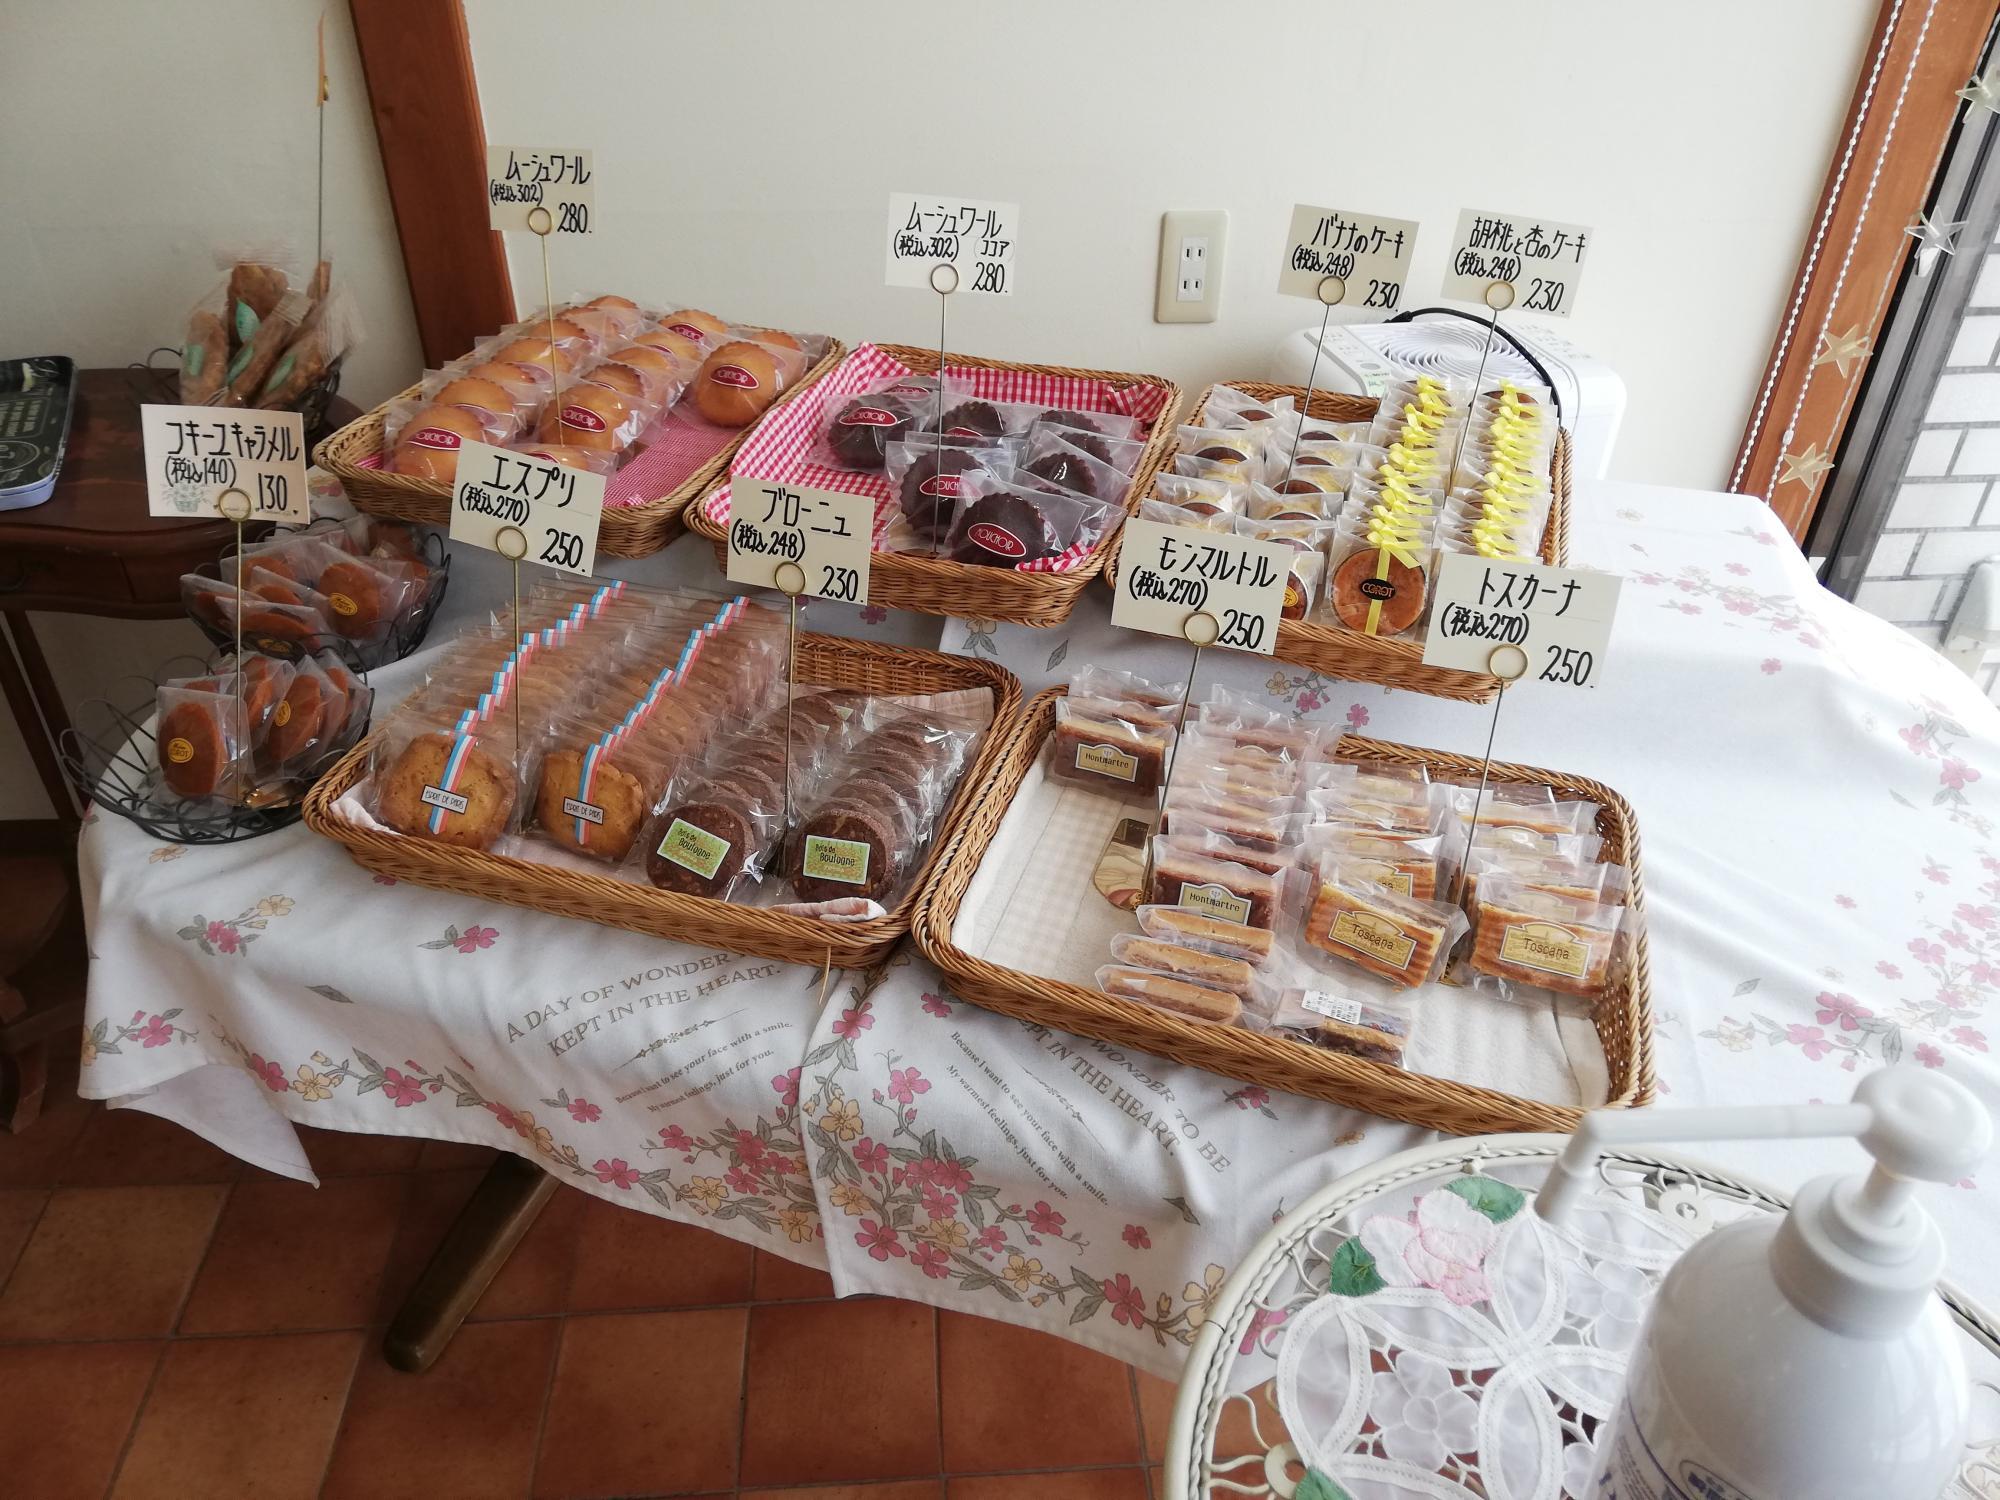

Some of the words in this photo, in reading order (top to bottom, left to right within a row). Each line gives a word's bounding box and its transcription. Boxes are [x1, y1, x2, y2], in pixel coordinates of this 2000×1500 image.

[505, 150, 591, 185] ムーシュワール
[490, 179, 543, 206] (税込302)
[905, 201, 1002, 239] ムーシュワール
[1310, 213, 1404, 259] バナナのケーキ
[1468, 216, 1586, 263] 胡桃と杏のケーキ
[893, 229, 959, 262] (税込302)
[1291, 244, 1355, 280] (税込248)
[1454, 247, 1521, 283] (税込248)
[165, 456, 236, 487] (税込140)
[482, 454, 576, 508] エスプリ
[459, 482, 530, 526] (税込270)
[762, 487, 852, 537] ブローニュ
[731, 518, 806, 562] (税込248)
[1159, 536, 1278, 588] モンマルトル
[1129, 565, 1209, 611] (税込270)
[1361, 582, 1394, 598] COROT
[1478, 567, 1582, 616] トスカーナ
[1440, 602, 1530, 645] (税込270)
[1085, 752, 1129, 769] Montmartre
[678, 837, 711, 860] Boulogne
[819, 852, 855, 867] Boulogne
[1189, 892, 1240, 912] Montmartre
[1351, 923, 1395, 950] Toscana
[1523, 937, 1570, 960] Toscana
[506, 1022, 525, 1043] A
[524, 997, 571, 1031] DAY
[580, 984, 615, 1003] OF
[619, 953, 731, 990] WONDER
[547, 1016, 601, 1057] KEPT
[608, 1003, 635, 1024] IN
[640, 988, 691, 1009] THE
[696, 964, 781, 996] HEART.
[684, 1055, 705, 1073] your
[707, 1046, 728, 1058] face
[730, 1033, 752, 1048] with
[762, 1022, 793, 1033] smile.
[715, 1067, 734, 1085] just
[735, 1058, 750, 1071] for
[752, 1049, 774, 1065] you.
[951, 1031, 980, 1064] Because
[983, 1066, 1003, 1086] want
[1001, 1083, 1010, 1094] to
[1010, 1094, 1023, 1109] see
[1023, 1109, 1043, 1131] your
[1041, 1130, 1058, 1152] face
[1058, 1151, 1076, 1174] with
[1075, 1172, 1082, 1181] a
[1082, 1180, 1108, 1206] smile.
[1046, 1040, 1075, 1061] IN
[1070, 1056, 1114, 1095] THE
[1110, 1087, 1181, 1156] HEART.
[946, 1064, 961, 1078] My
[959, 1078, 990, 1110] warmest
[987, 1107, 1019, 1149] feelings,
[1017, 1147, 1036, 1168] just
[1035, 1166, 1050, 1182] for
[1048, 1182, 1068, 1199] you.
[1174, 1108, 1201, 1140] TO
[1197, 1141, 1231, 1174] BE
